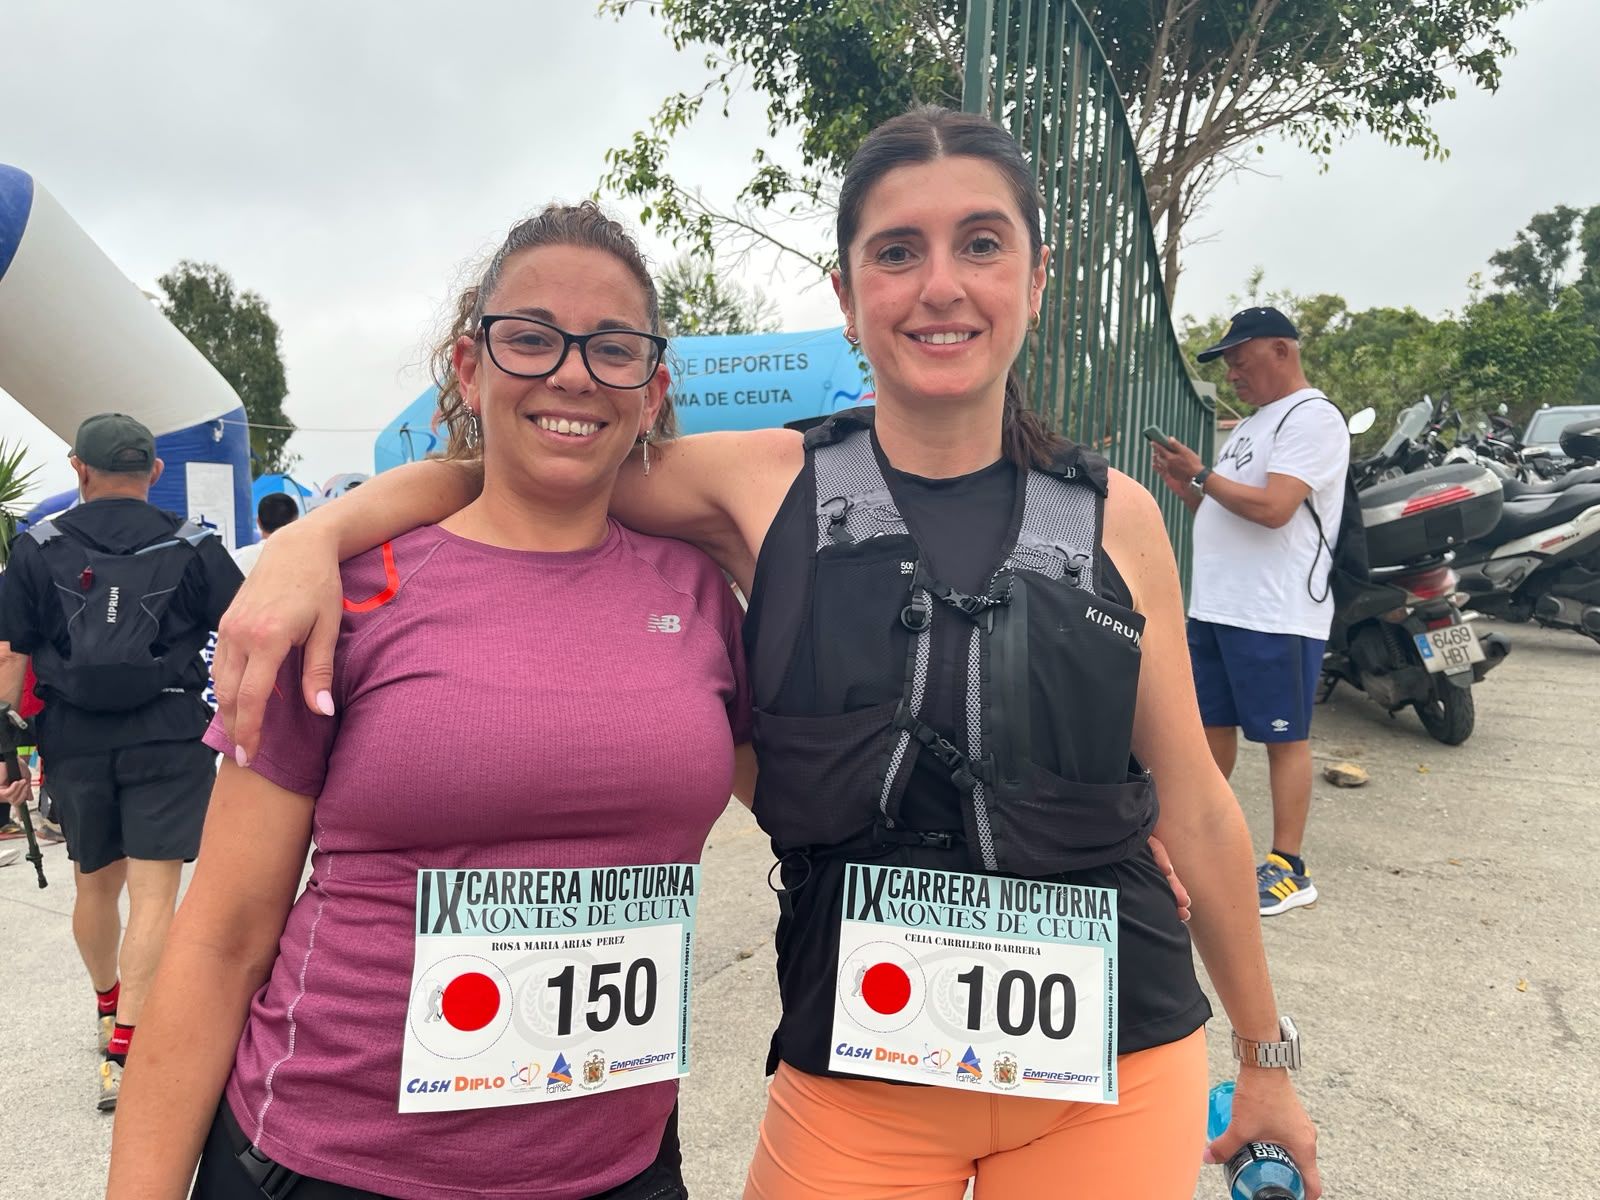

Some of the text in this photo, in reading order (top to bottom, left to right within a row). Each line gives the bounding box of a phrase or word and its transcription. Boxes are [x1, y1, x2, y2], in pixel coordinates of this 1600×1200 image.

[674, 353, 808, 376] DE DEPORTES
[675, 389, 792, 407] MA DE CEUTA
[107, 587, 120, 623] KIPRUN
[1085, 606, 1141, 647] KIPRUN
[1432, 626, 1471, 649] 6469
[1441, 645, 1471, 665] HBT
[420, 871, 466, 934] IX
[468, 866, 694, 904] CARRERA NOCTURNA
[846, 866, 888, 922] IX
[888, 870, 1112, 920] CARRERA NOCTURNA
[465, 898, 691, 934] MONTES DE CEUTA
[886, 901, 1112, 942] MONTES DE CEUTA
[491, 936, 625, 952] ROSA MARIA ARIAS PEREZ
[905, 933, 1041, 955] CELIA CARRILERO BARRERA
[548, 958, 658, 1036] 150
[958, 966, 1076, 1040] 100
[836, 1043, 918, 1066] CASH DIPLO
[406, 1078, 452, 1094] CASH
[454, 1076, 505, 1092] DIPLO
